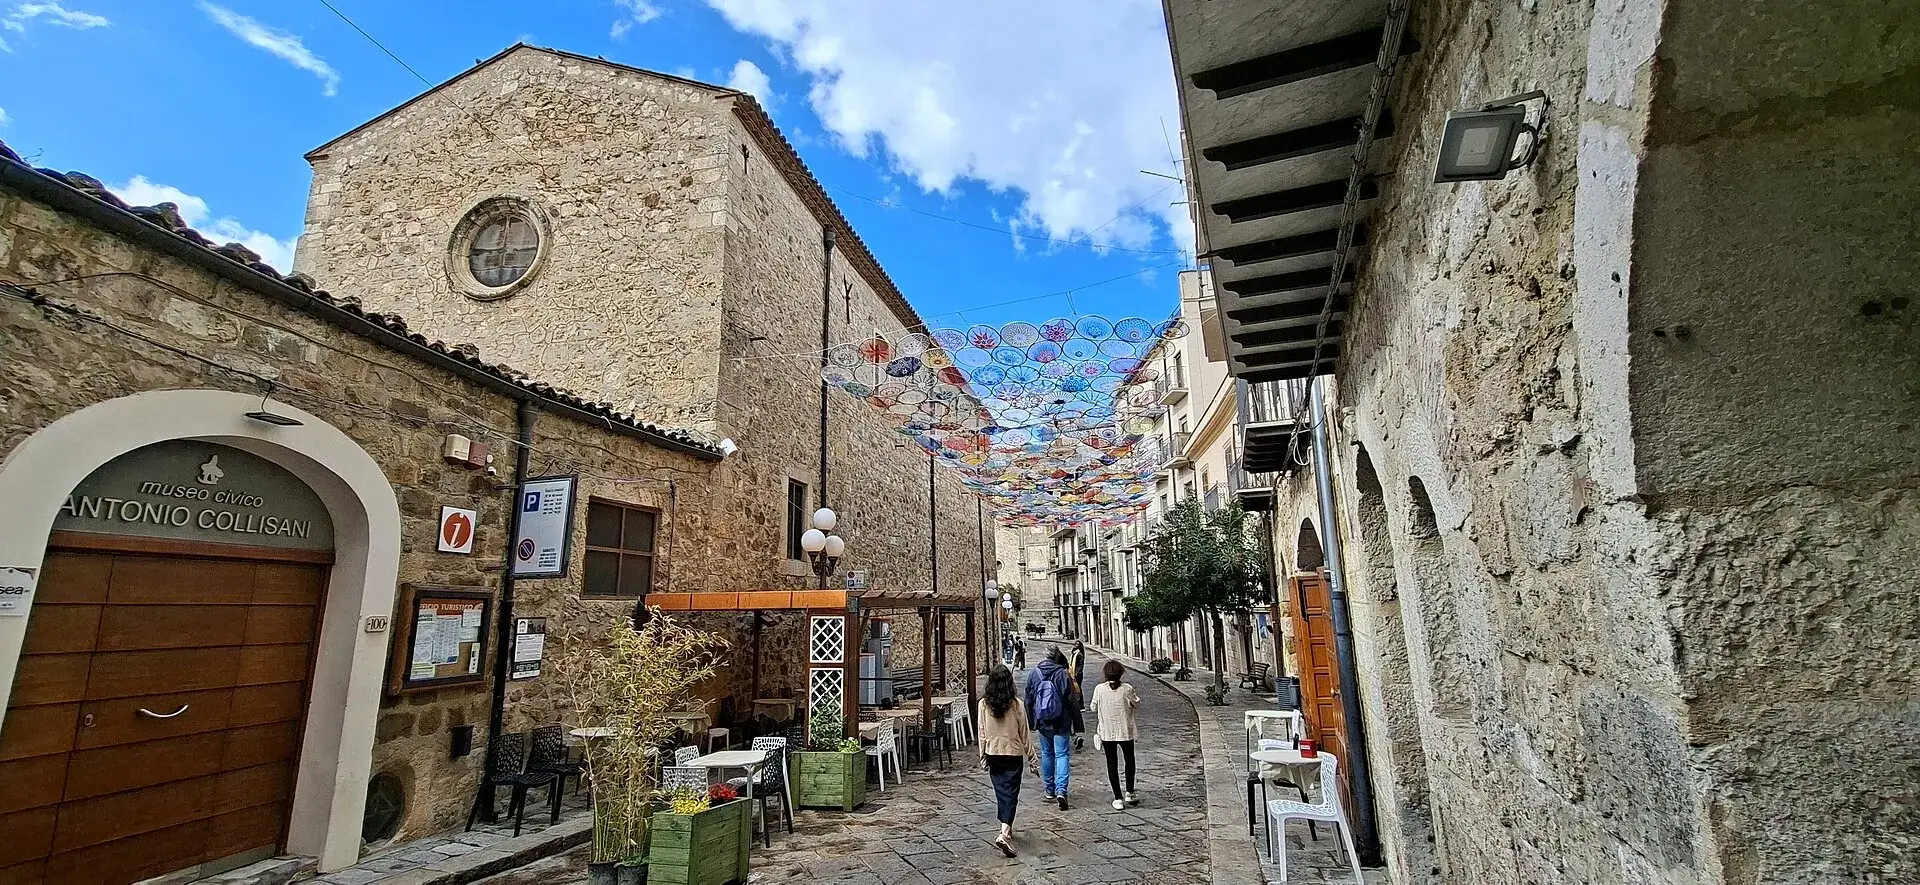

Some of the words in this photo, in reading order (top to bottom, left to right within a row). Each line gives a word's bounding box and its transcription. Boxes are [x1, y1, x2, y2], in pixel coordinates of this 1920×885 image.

[141, 481, 209, 501] museo
[215, 489, 264, 508] civico
[527, 494, 537, 509] P
[61, 494, 190, 526] ANTONIO
[198, 509, 311, 538] COLLISANI
[441, 603, 473, 612] TURISTICO
